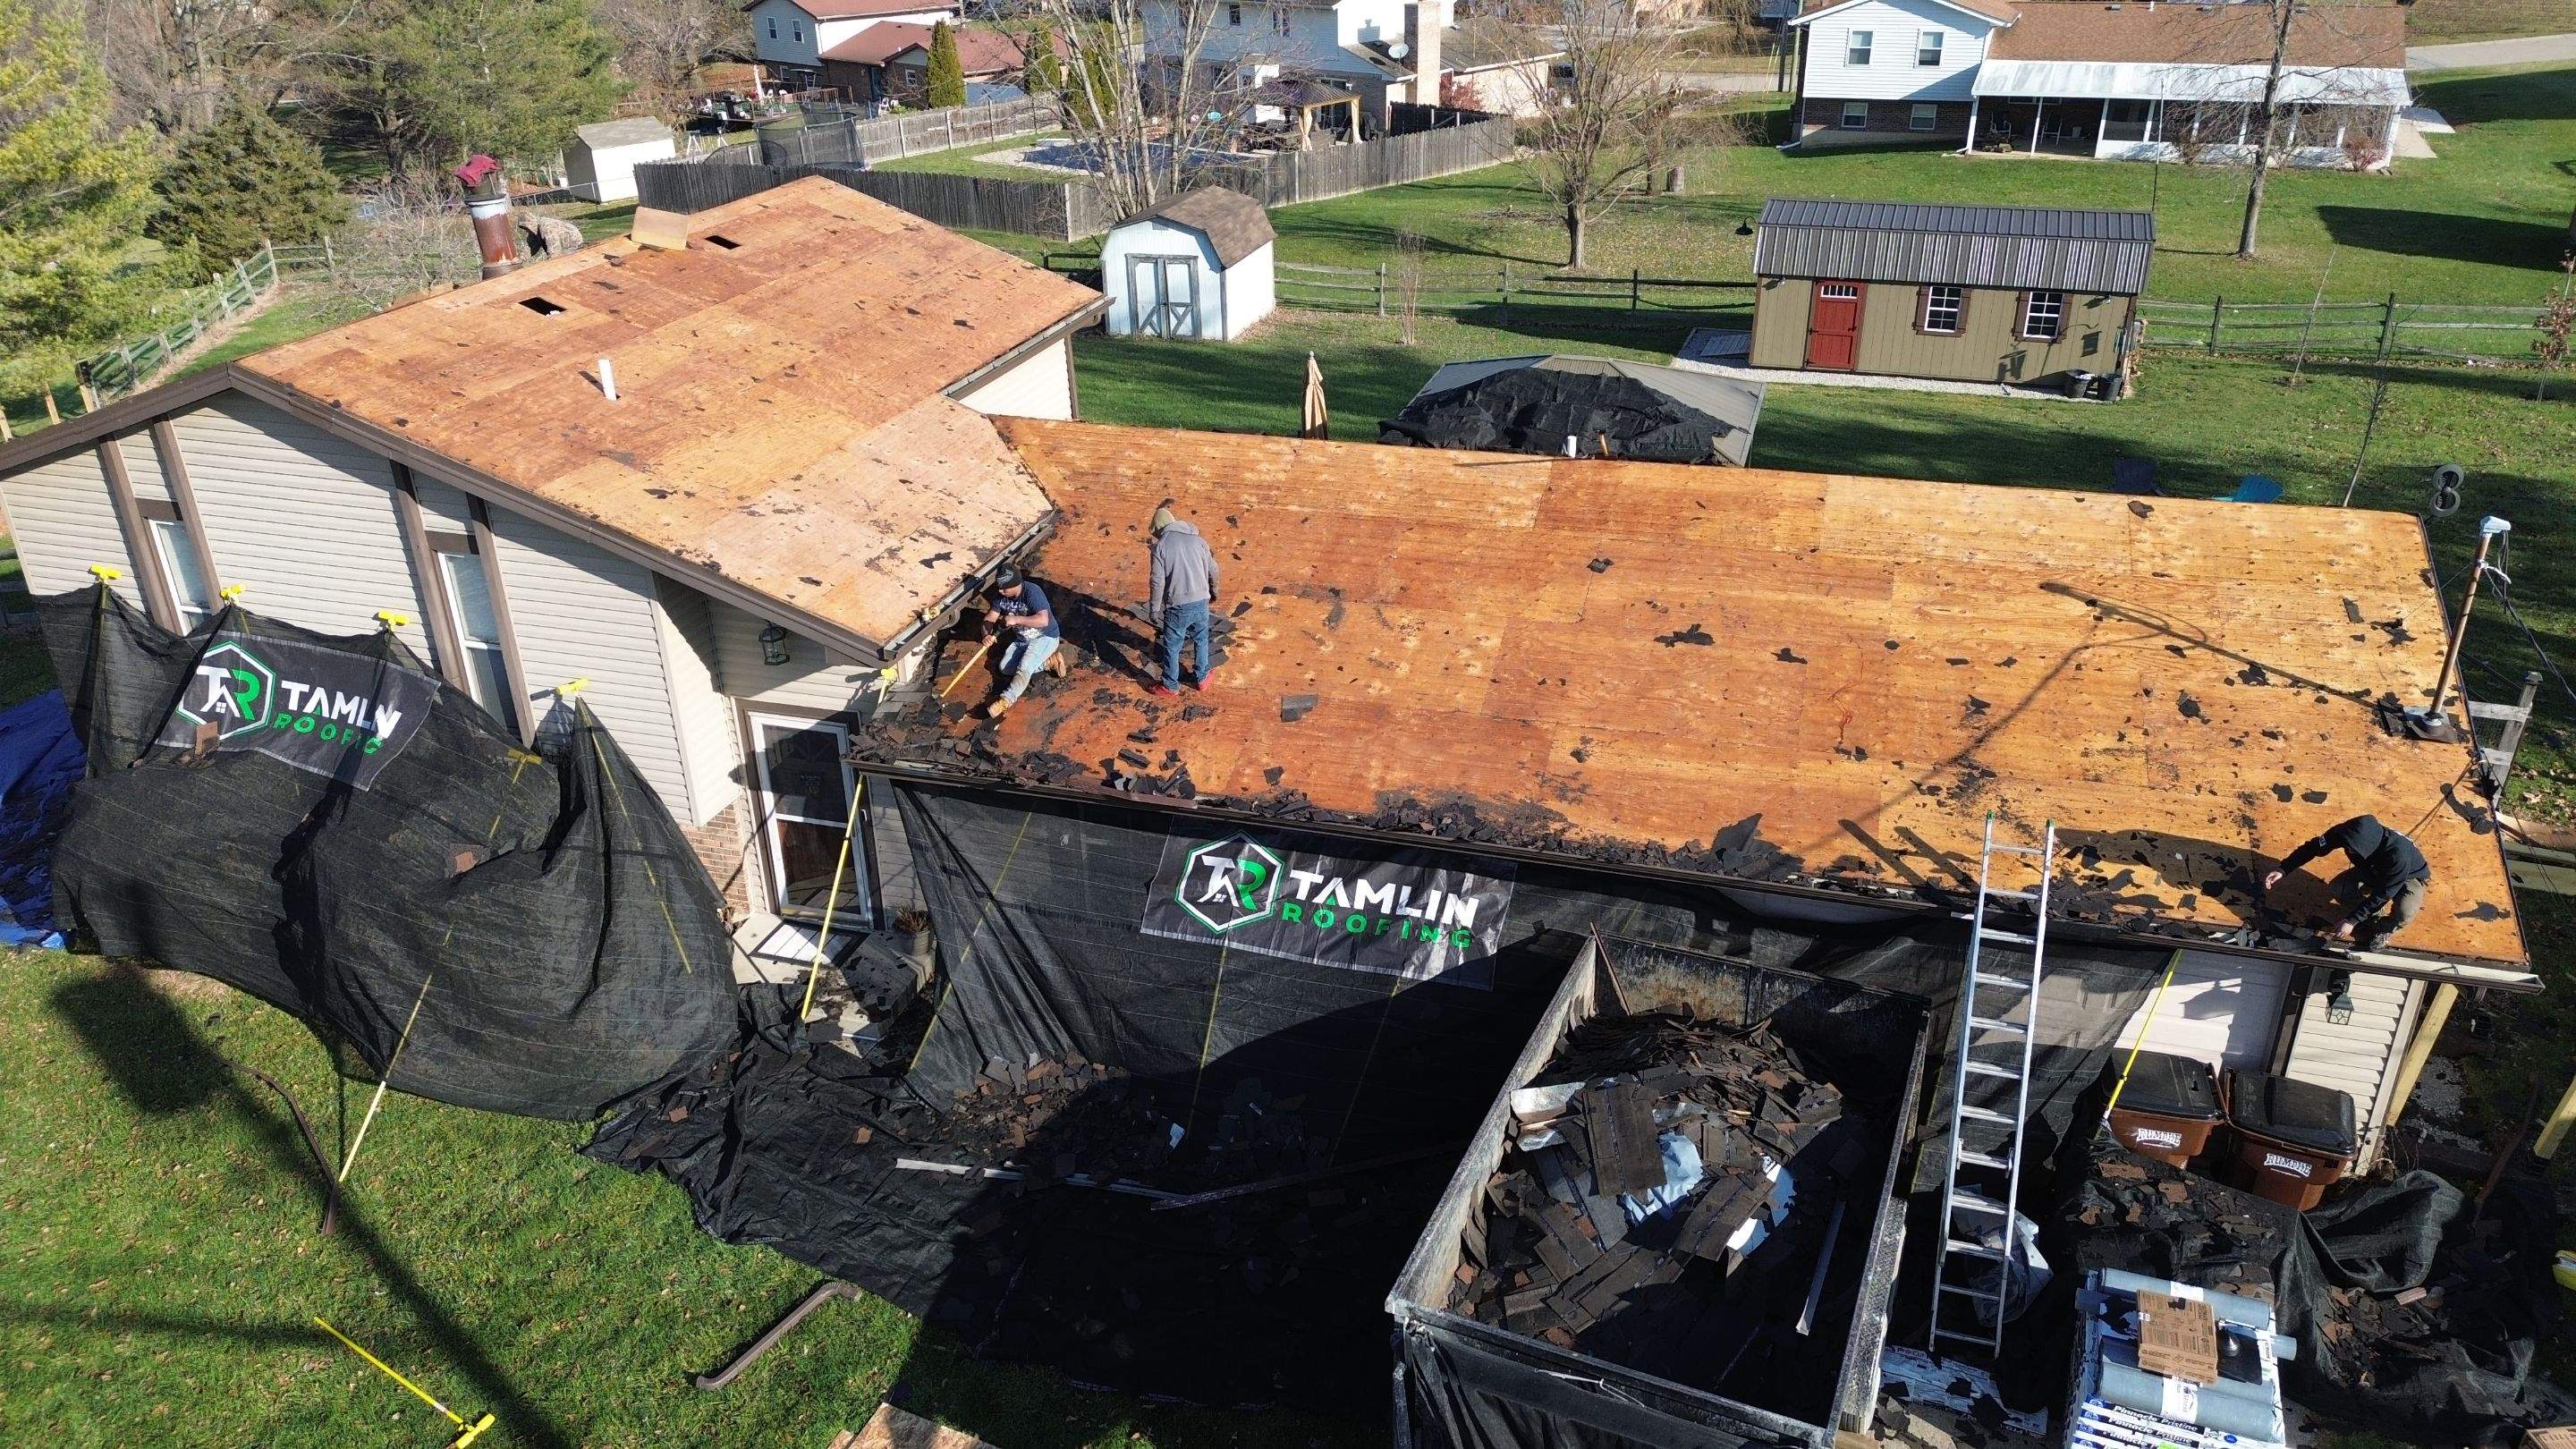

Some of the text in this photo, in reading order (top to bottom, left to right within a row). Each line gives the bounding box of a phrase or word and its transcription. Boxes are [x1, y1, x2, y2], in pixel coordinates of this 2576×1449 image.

[281, 680, 402, 739] TAMLN
[274, 712, 384, 756] ROOFG
[1290, 869, 1479, 929] TAMLIN
[1282, 902, 1473, 949] ROOFING
[2113, 1405, 2158, 1422] Pinnacle
[2161, 1418, 2198, 1432] Pristine
